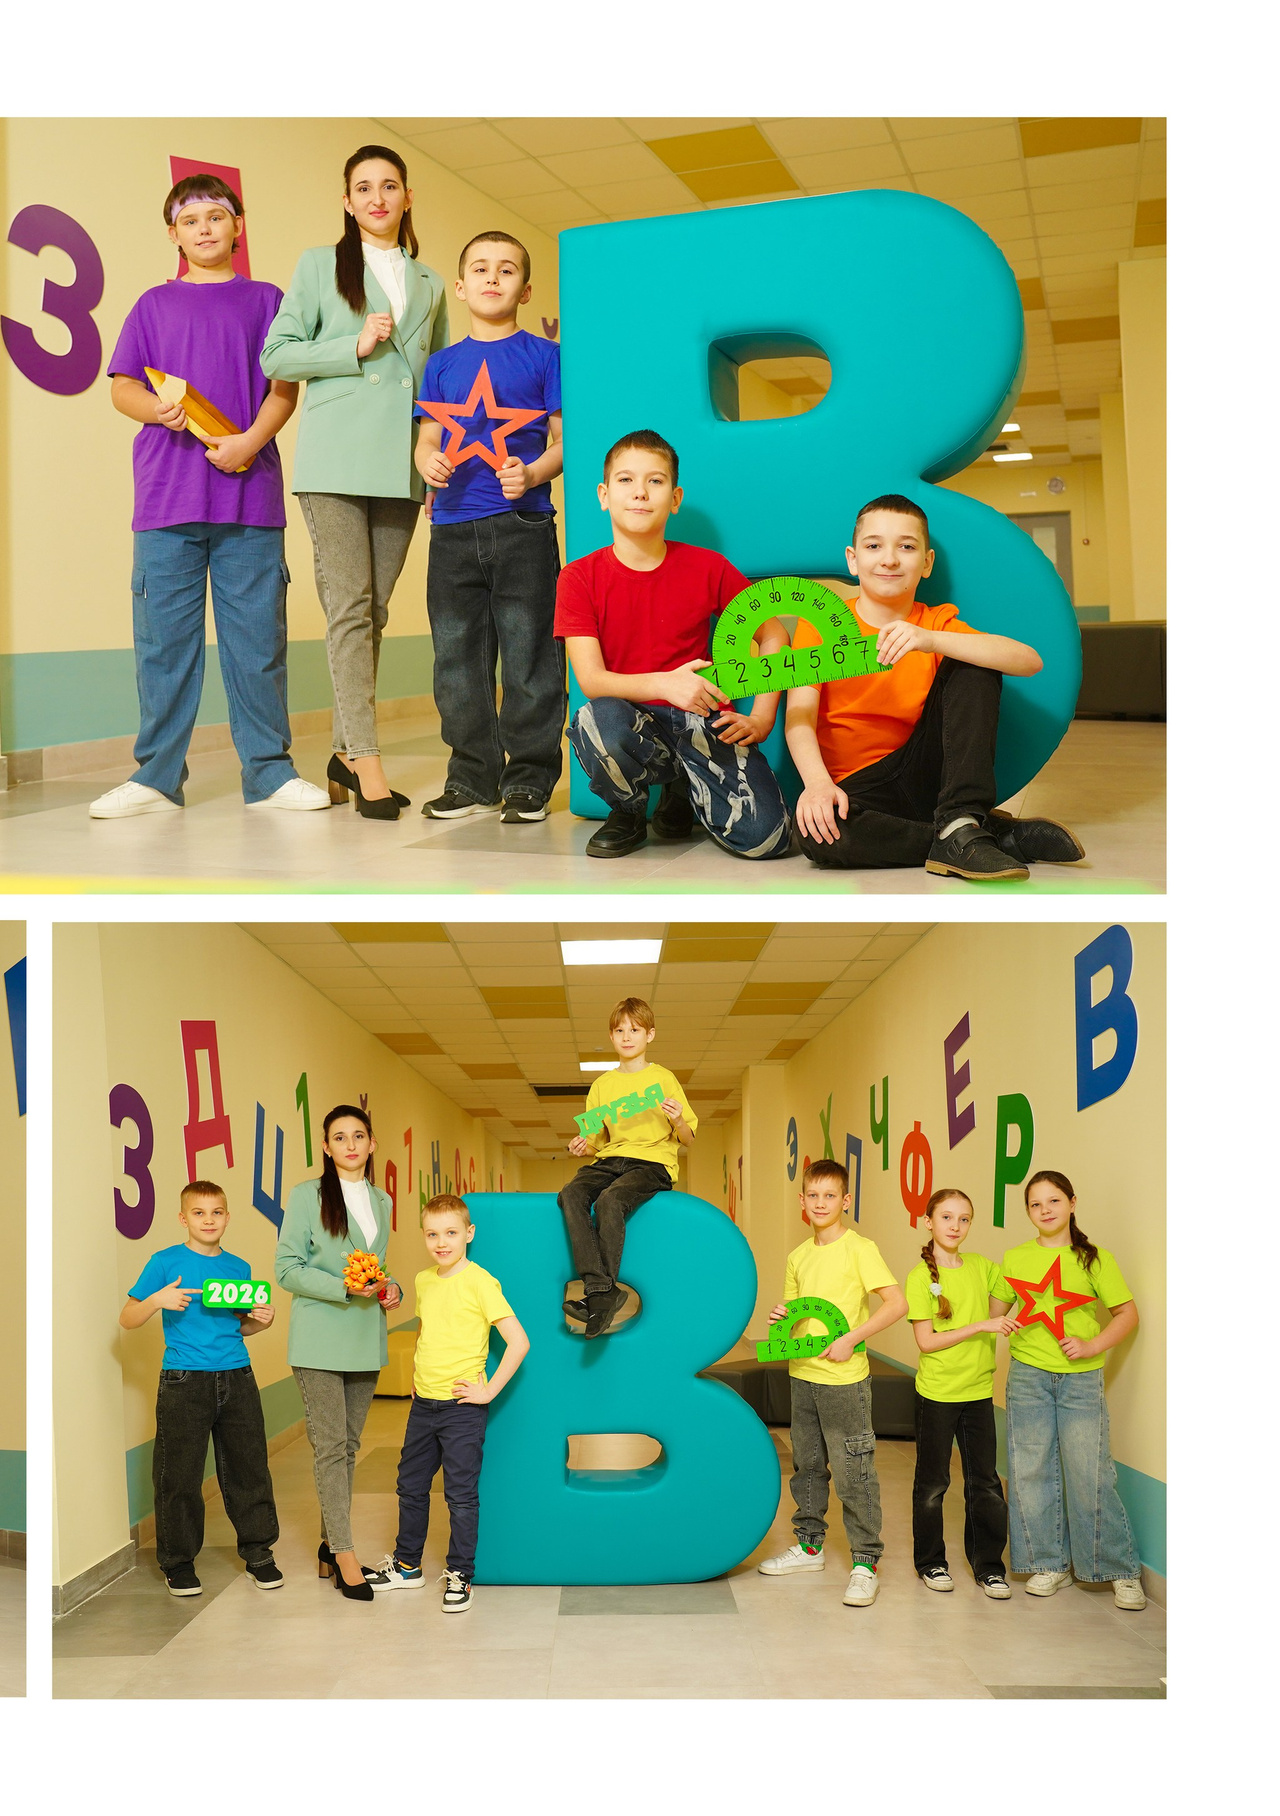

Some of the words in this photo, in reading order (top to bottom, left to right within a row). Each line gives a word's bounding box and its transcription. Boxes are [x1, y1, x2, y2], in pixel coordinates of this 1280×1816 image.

[725, 633, 737, 646] 20
[733, 613, 747, 626] 40
[749, 598, 761, 612] 60
[769, 591, 782, 604] 90
[790, 591, 805, 603] 120
[811, 598, 826, 611] 140
[829, 613, 842, 628] 160
[711, 668, 722, 688] 1
[735, 662, 749, 684] 2
[760, 658, 772, 679] 3
[783, 654, 796, 673] 4
[809, 649, 821, 669] 5
[832, 643, 845, 665] 6
[854, 640, 870, 660] 7
[1074, 924, 1139, 1113] В
[180, 1020, 235, 1183] Д
[573, 1082, 665, 1140] ДРУЗЬЯ
[944, 1010, 976, 1150] Е
[869, 1075, 889, 1171] Ч
[900, 1120, 933, 1229] Ф
[208, 1282, 269, 1304] 2026
[766, 1342, 772, 1354] 1
[780, 1340, 787, 1353] 2
[793, 1339, 801, 1351] 3
[806, 1338, 814, 1349] 4
[820, 1337, 828, 1348] 5
